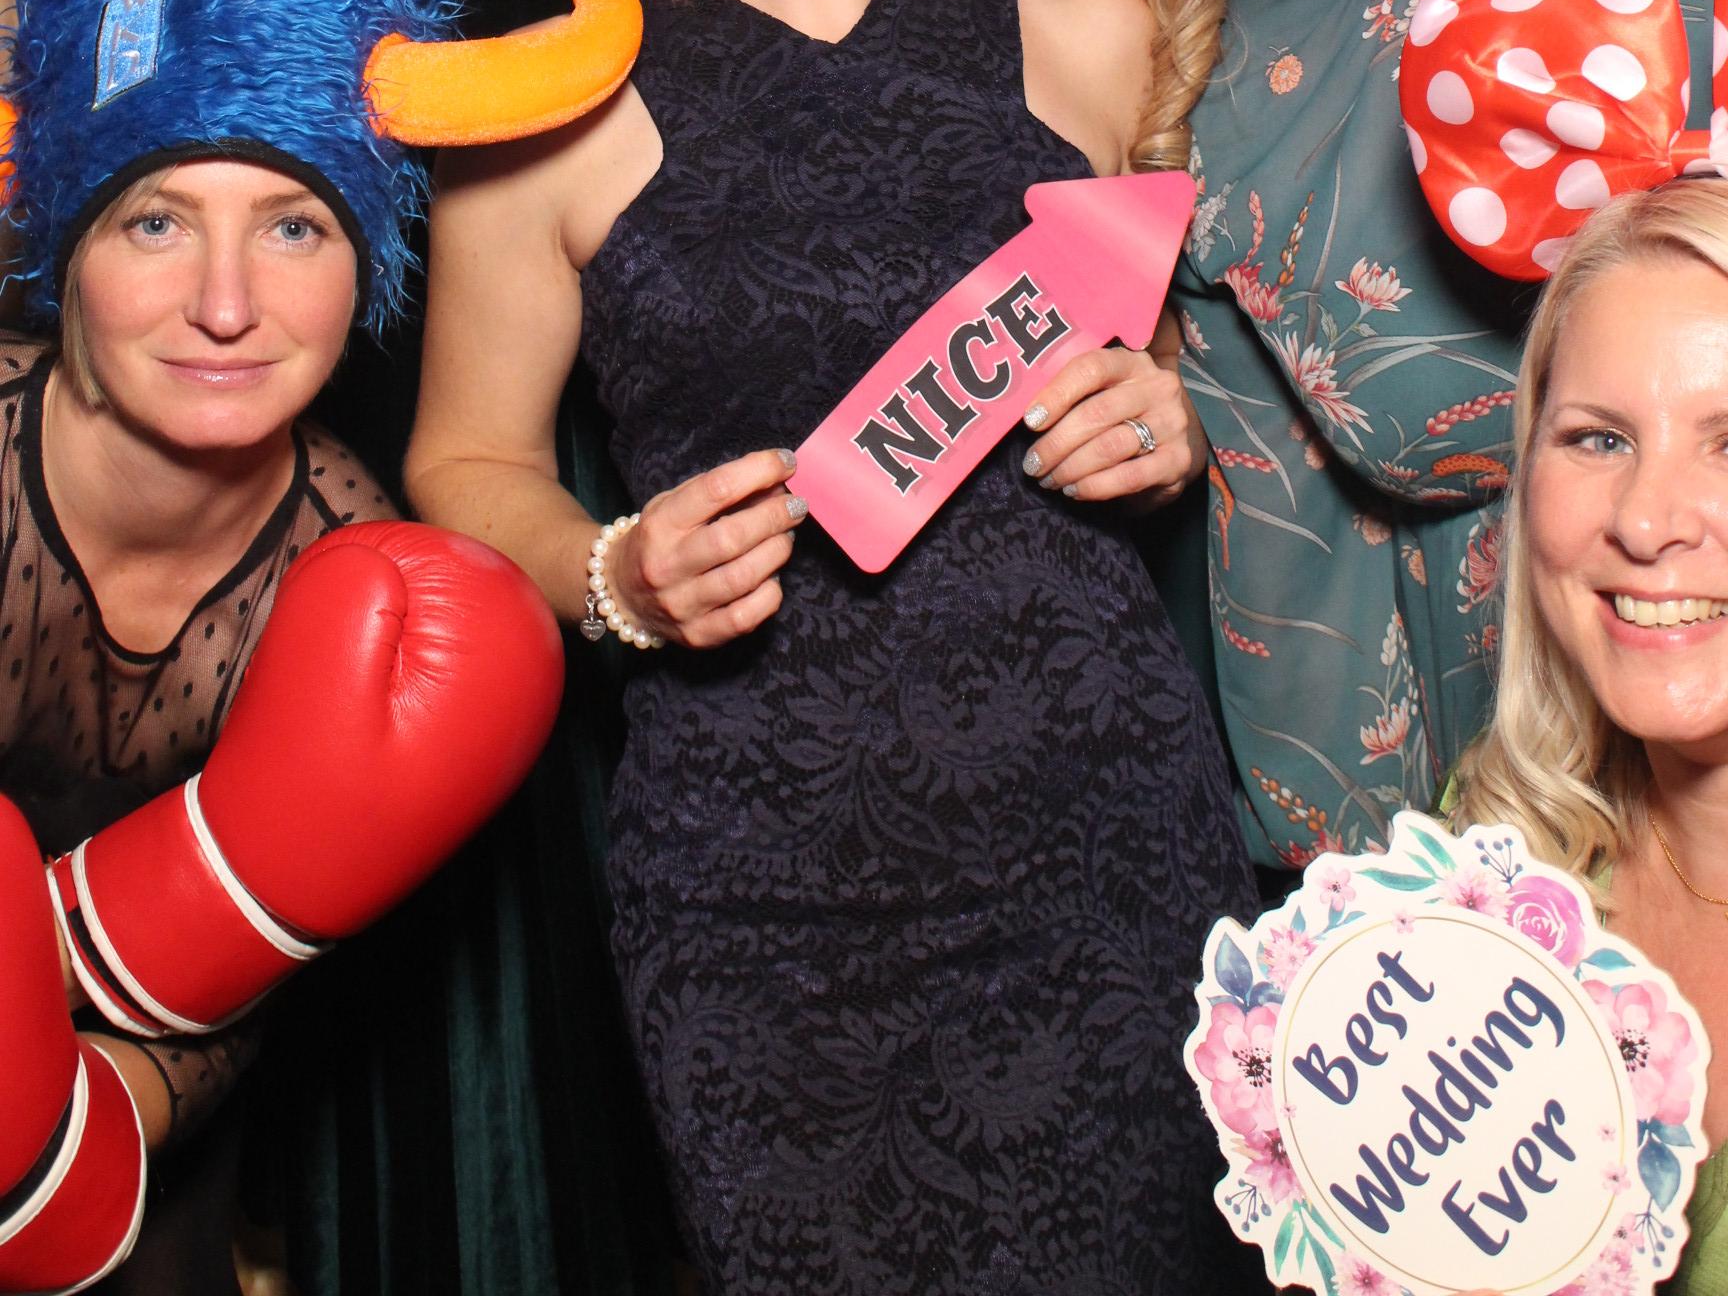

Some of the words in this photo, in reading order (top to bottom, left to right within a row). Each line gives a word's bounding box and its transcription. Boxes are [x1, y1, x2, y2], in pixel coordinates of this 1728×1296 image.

[850, 271, 1072, 496] NICE
[1292, 950, 1435, 1106] Best
[1329, 976, 1566, 1234] Wedding
[1441, 1099, 1576, 1256] Ever
